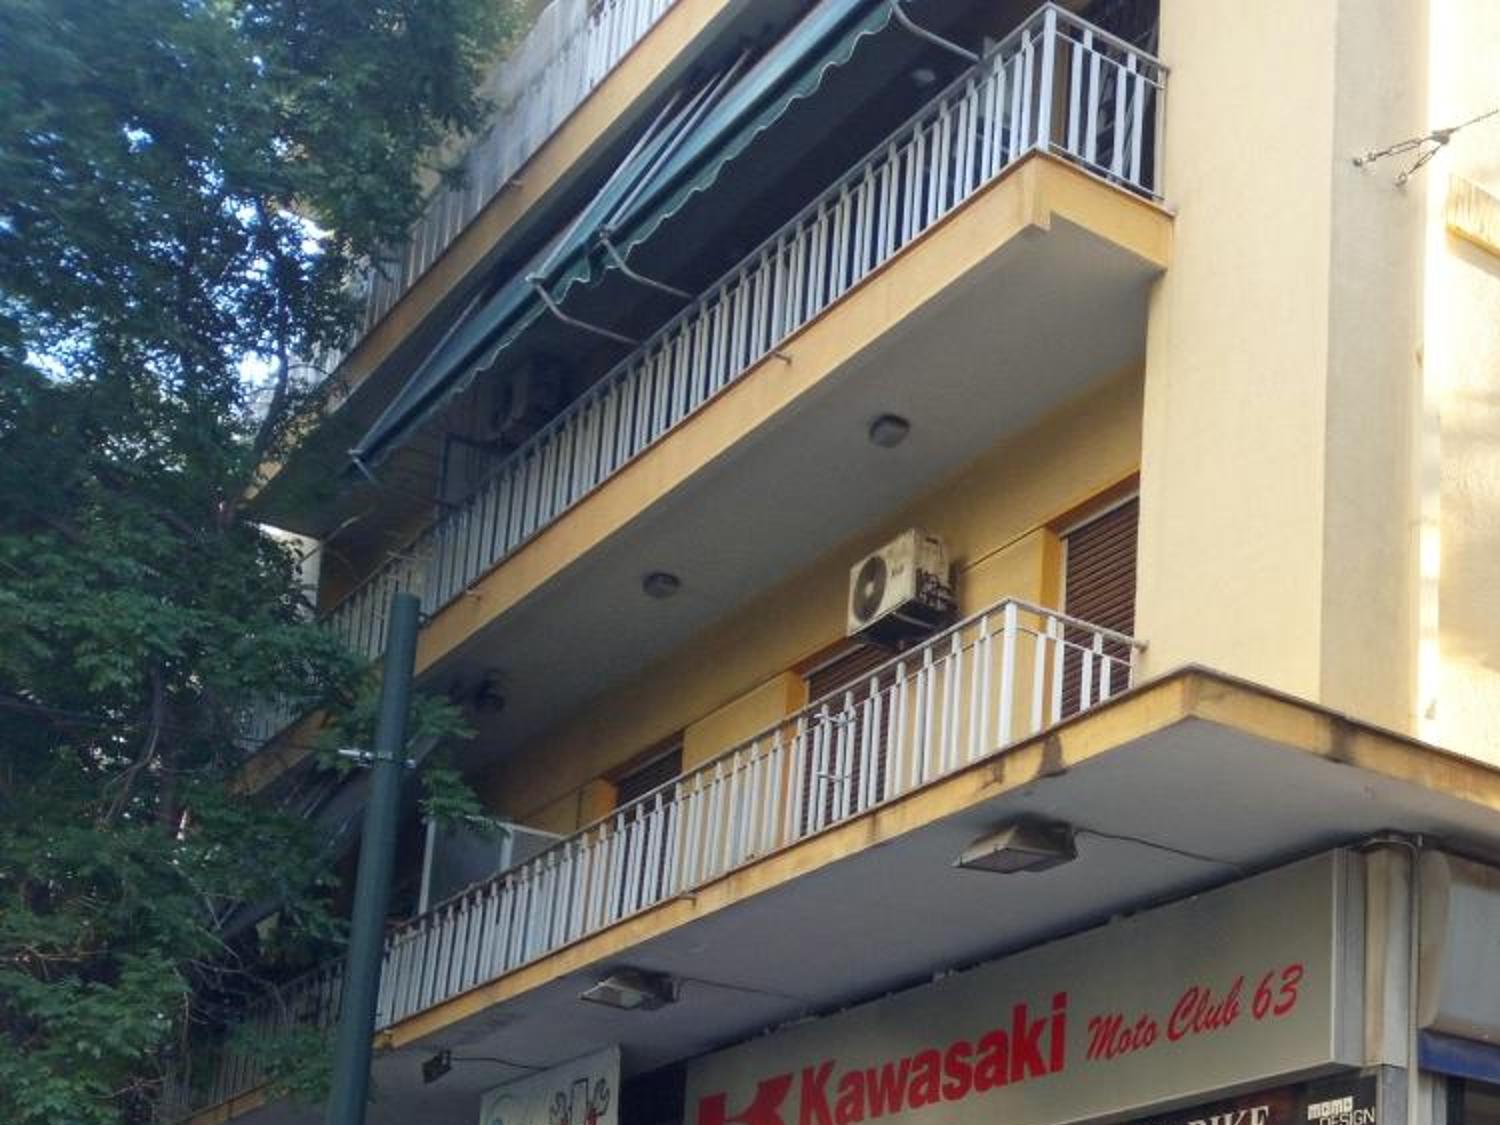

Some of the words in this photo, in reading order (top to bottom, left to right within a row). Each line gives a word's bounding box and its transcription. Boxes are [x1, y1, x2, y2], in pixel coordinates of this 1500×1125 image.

[1086, 1013, 1157, 1060] Moto
[1167, 974, 1244, 1041] Club
[1252, 963, 1304, 1020] 63
